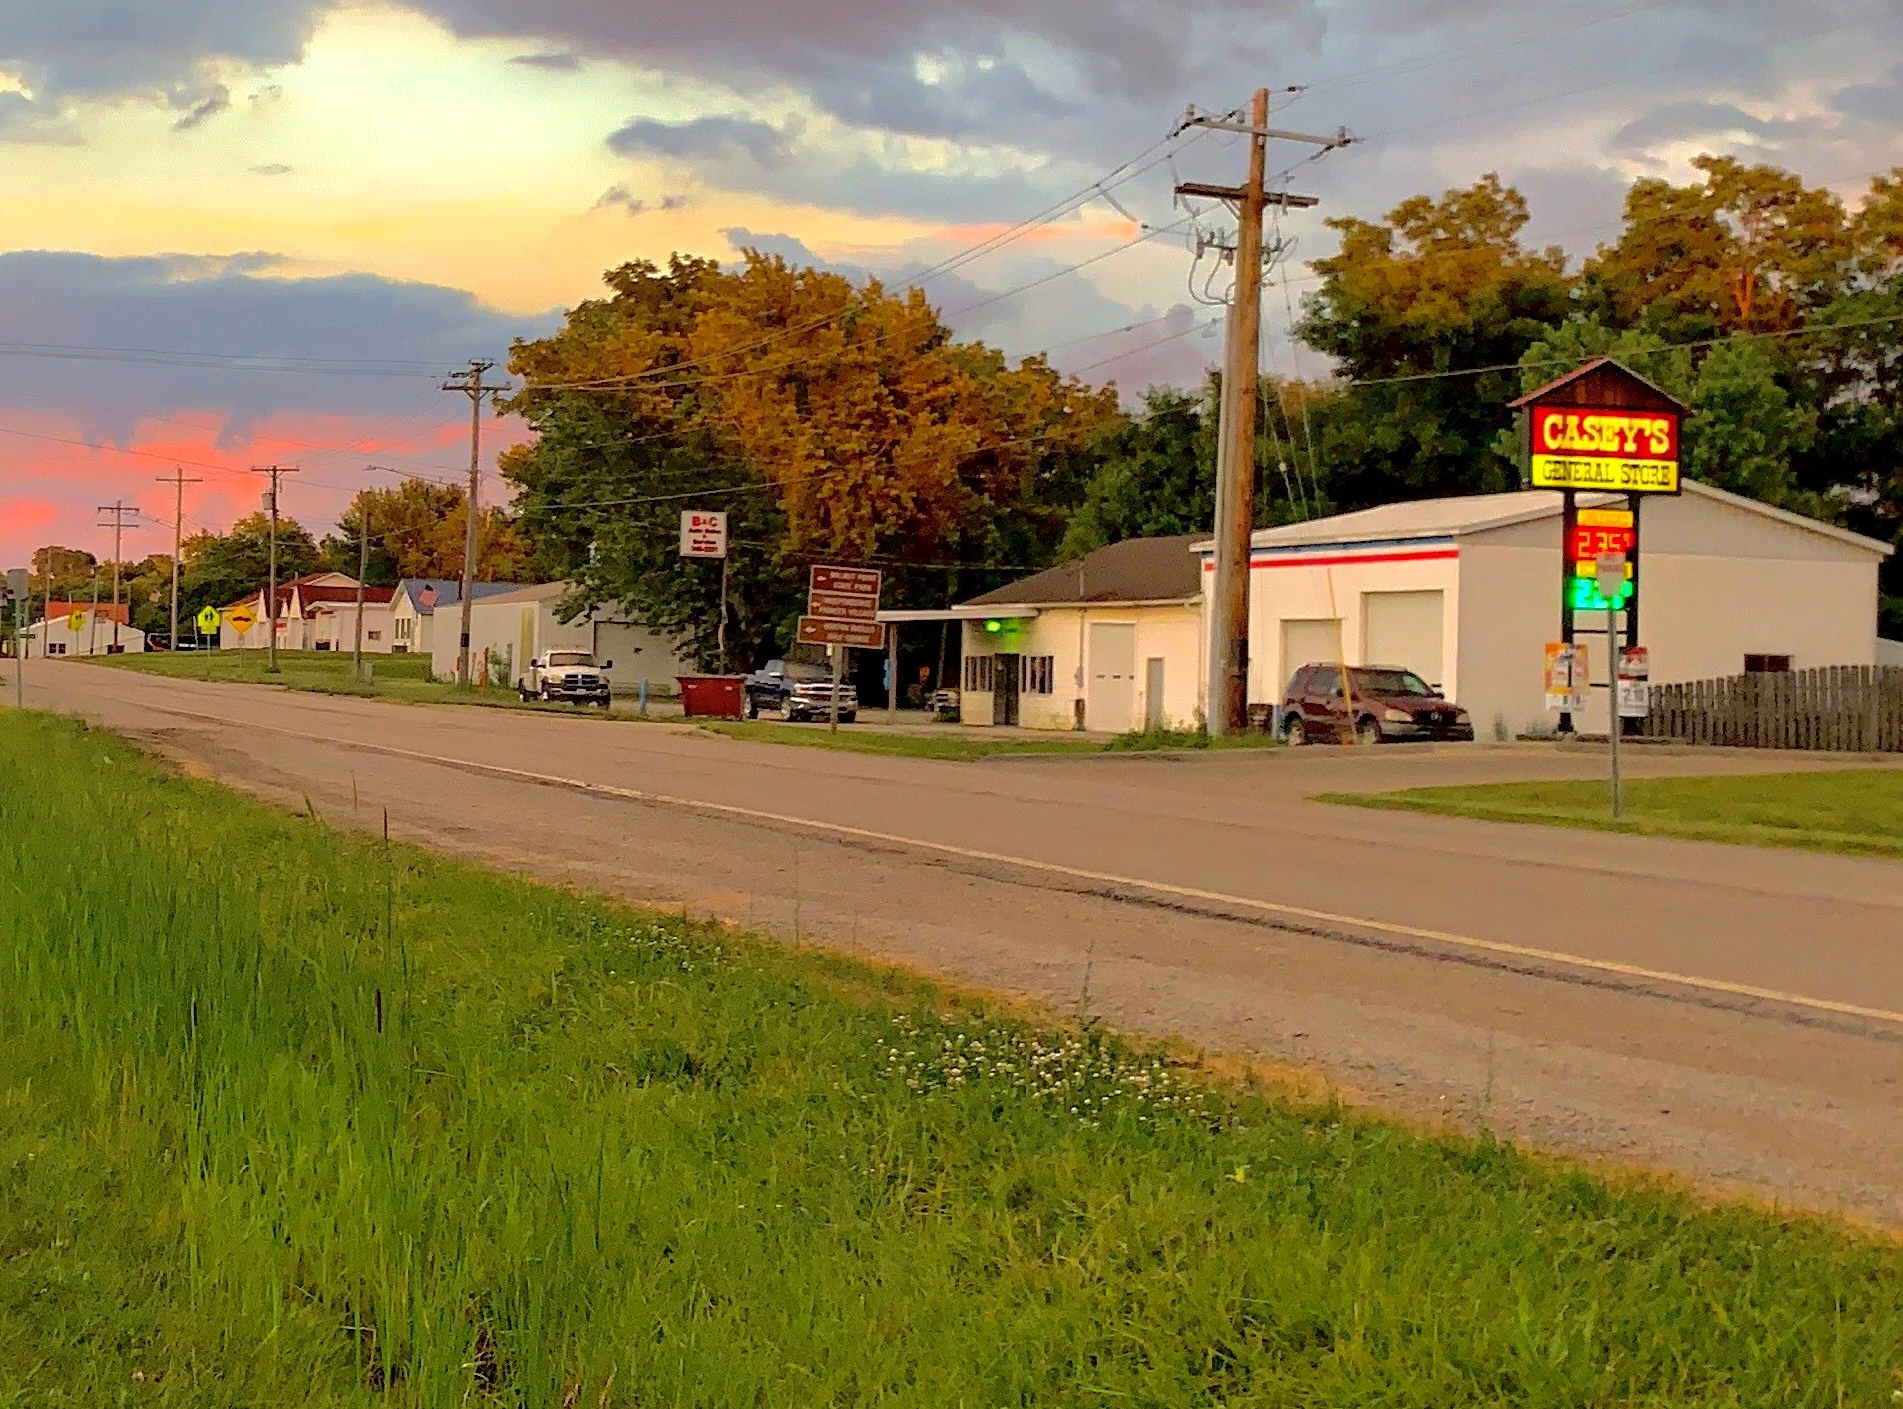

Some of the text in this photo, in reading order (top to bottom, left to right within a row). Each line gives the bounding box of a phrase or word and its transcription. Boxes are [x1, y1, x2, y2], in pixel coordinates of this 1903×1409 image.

[1543, 413, 1670, 455] CASEY'S
[1543, 460, 1671, 486] GENERAL STORE
